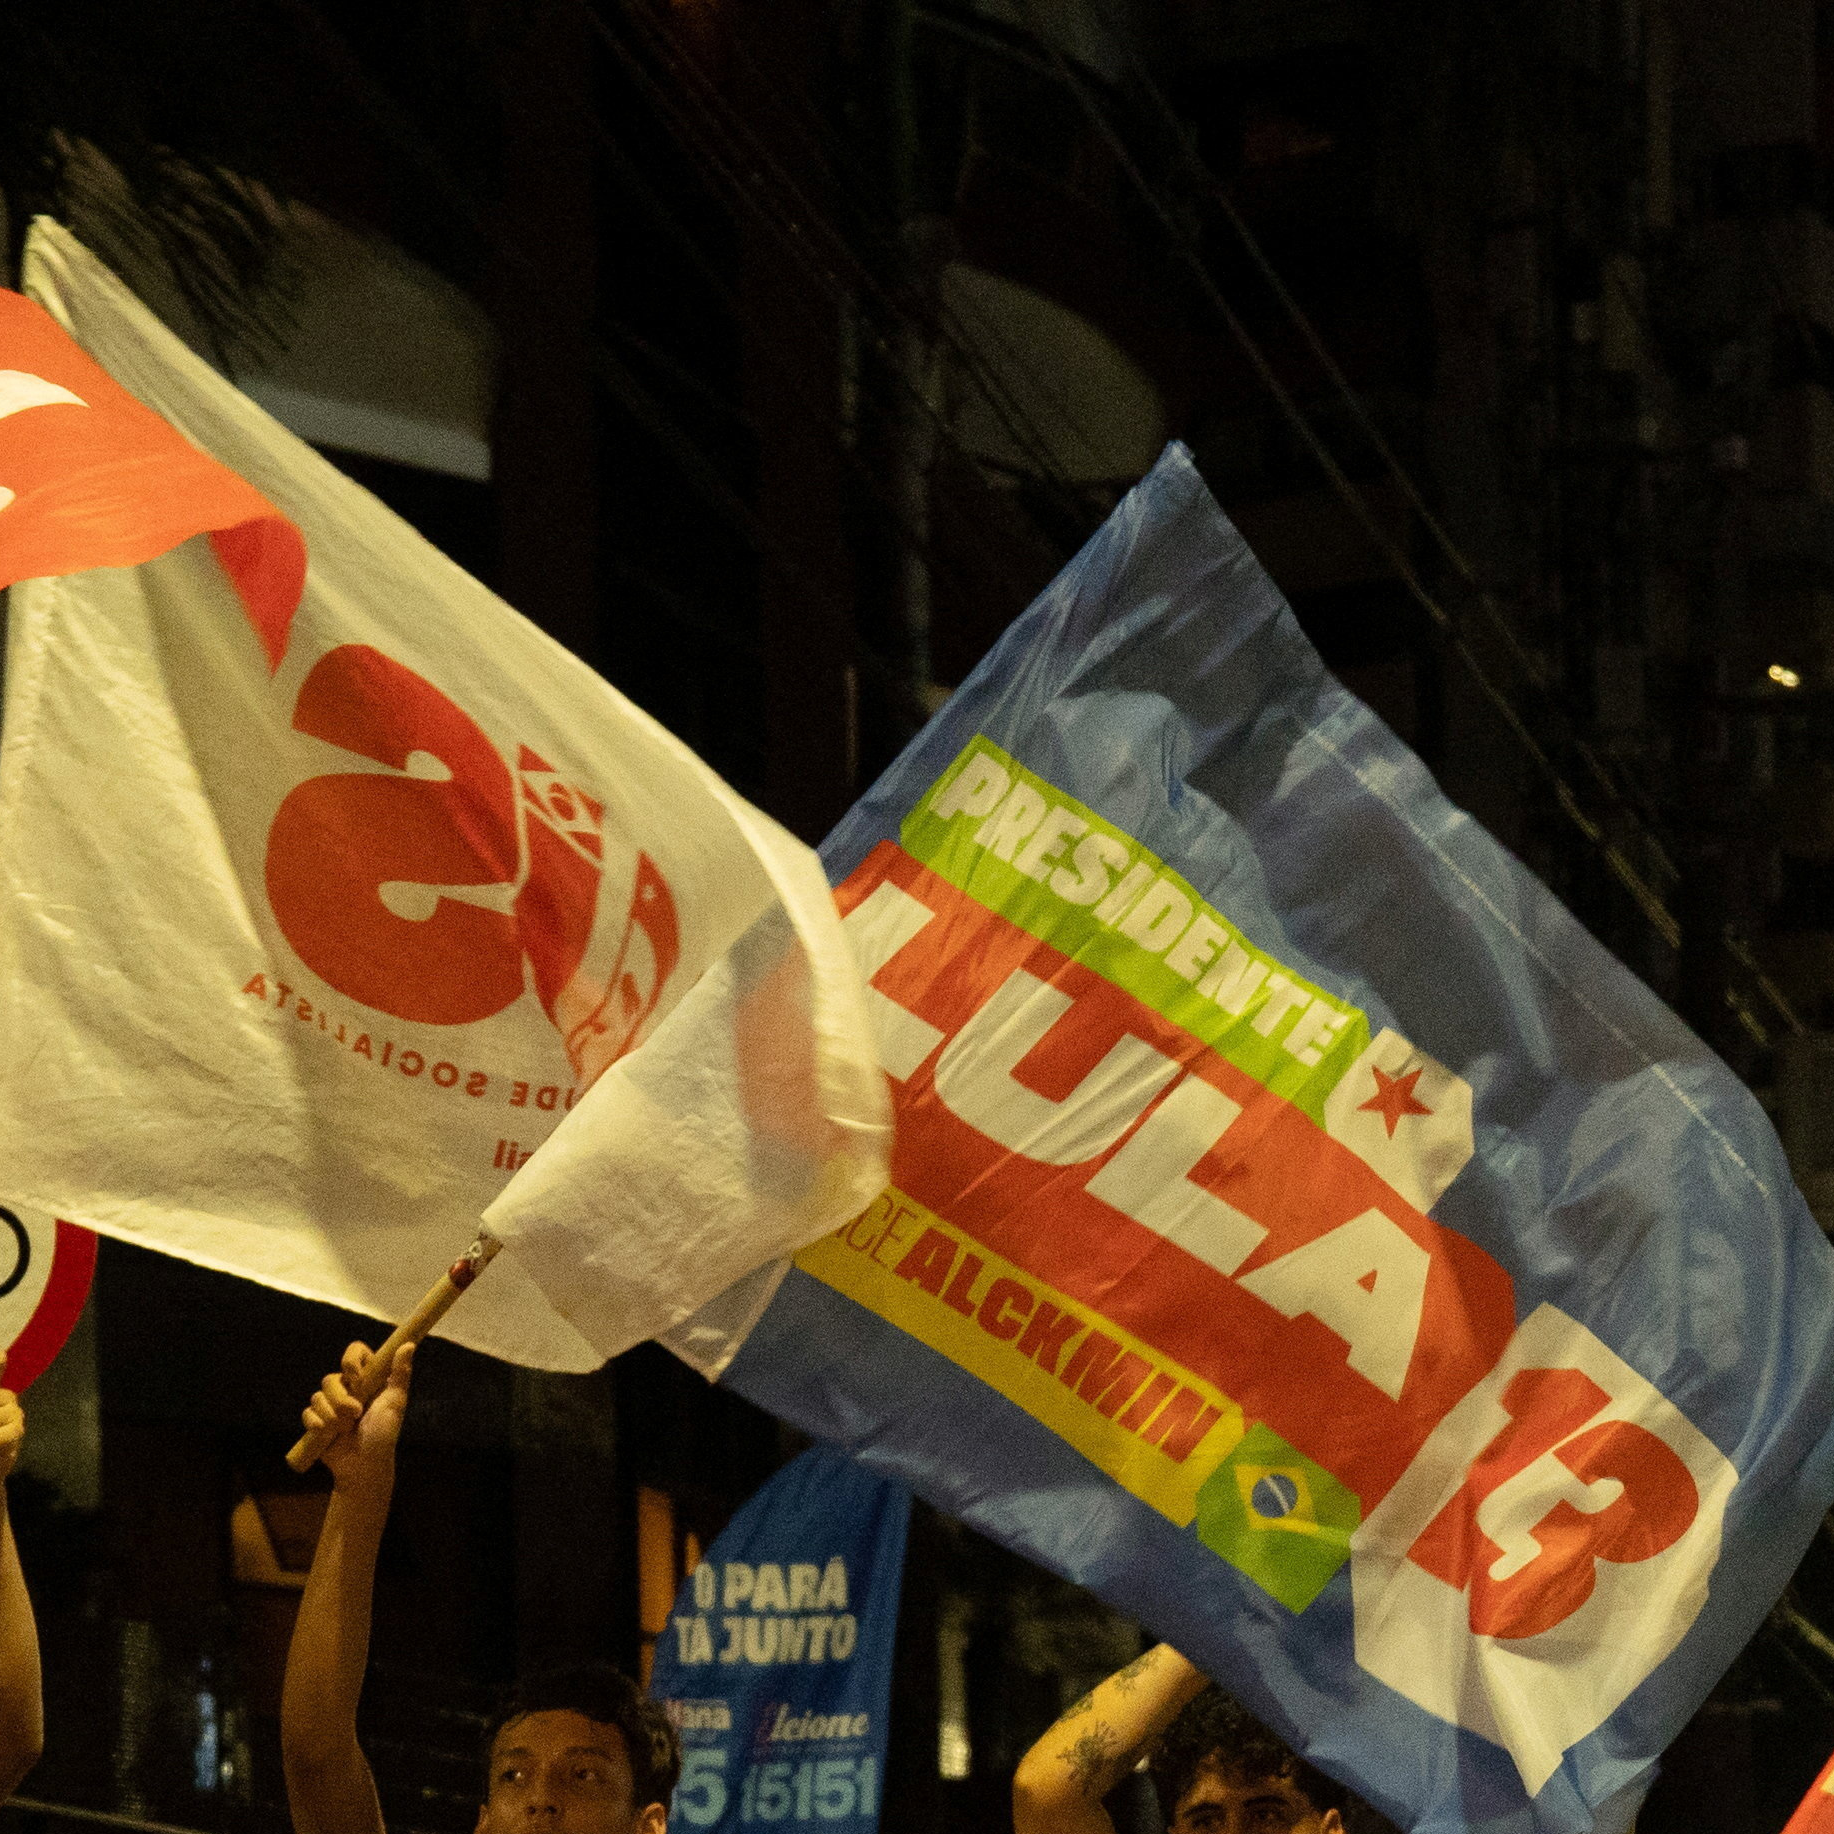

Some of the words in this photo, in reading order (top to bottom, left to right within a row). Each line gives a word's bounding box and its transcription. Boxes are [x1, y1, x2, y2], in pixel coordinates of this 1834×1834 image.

[934, 750, 1348, 1069] PRESIDENTE
[838, 879, 1432, 1402] LULA
[893, 1228, 1224, 1466] ALCKMIN
[719, 1613, 857, 1666] JUNTO
[1406, 1366, 1700, 1640] 13
